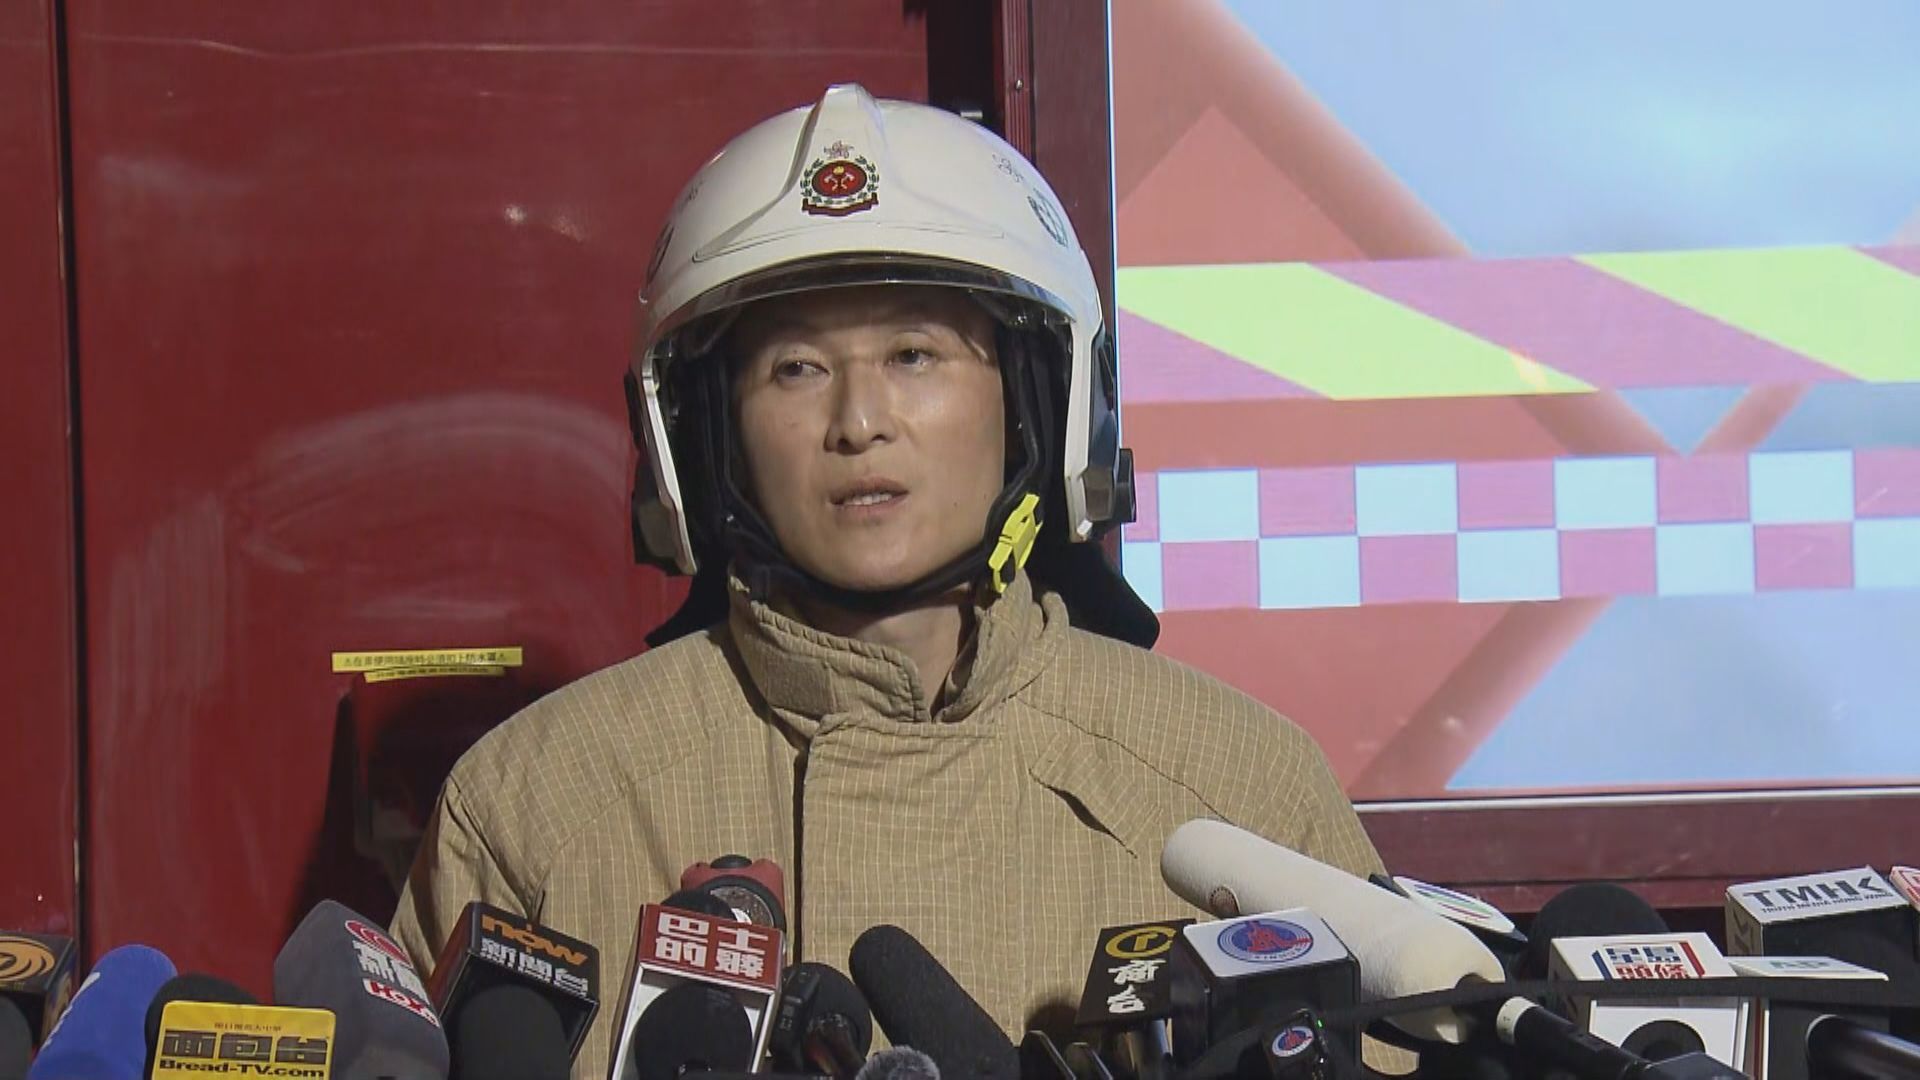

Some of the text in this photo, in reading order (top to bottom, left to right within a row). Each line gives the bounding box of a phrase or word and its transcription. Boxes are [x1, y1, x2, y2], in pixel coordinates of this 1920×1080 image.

[1744, 876, 1884, 907] TMHK
[482, 914, 588, 966] now
[657, 911, 769, 955] 巴士
[480, 937, 588, 998] 新聞台
[159, 1059, 325, 1078] Bread-TV.com
